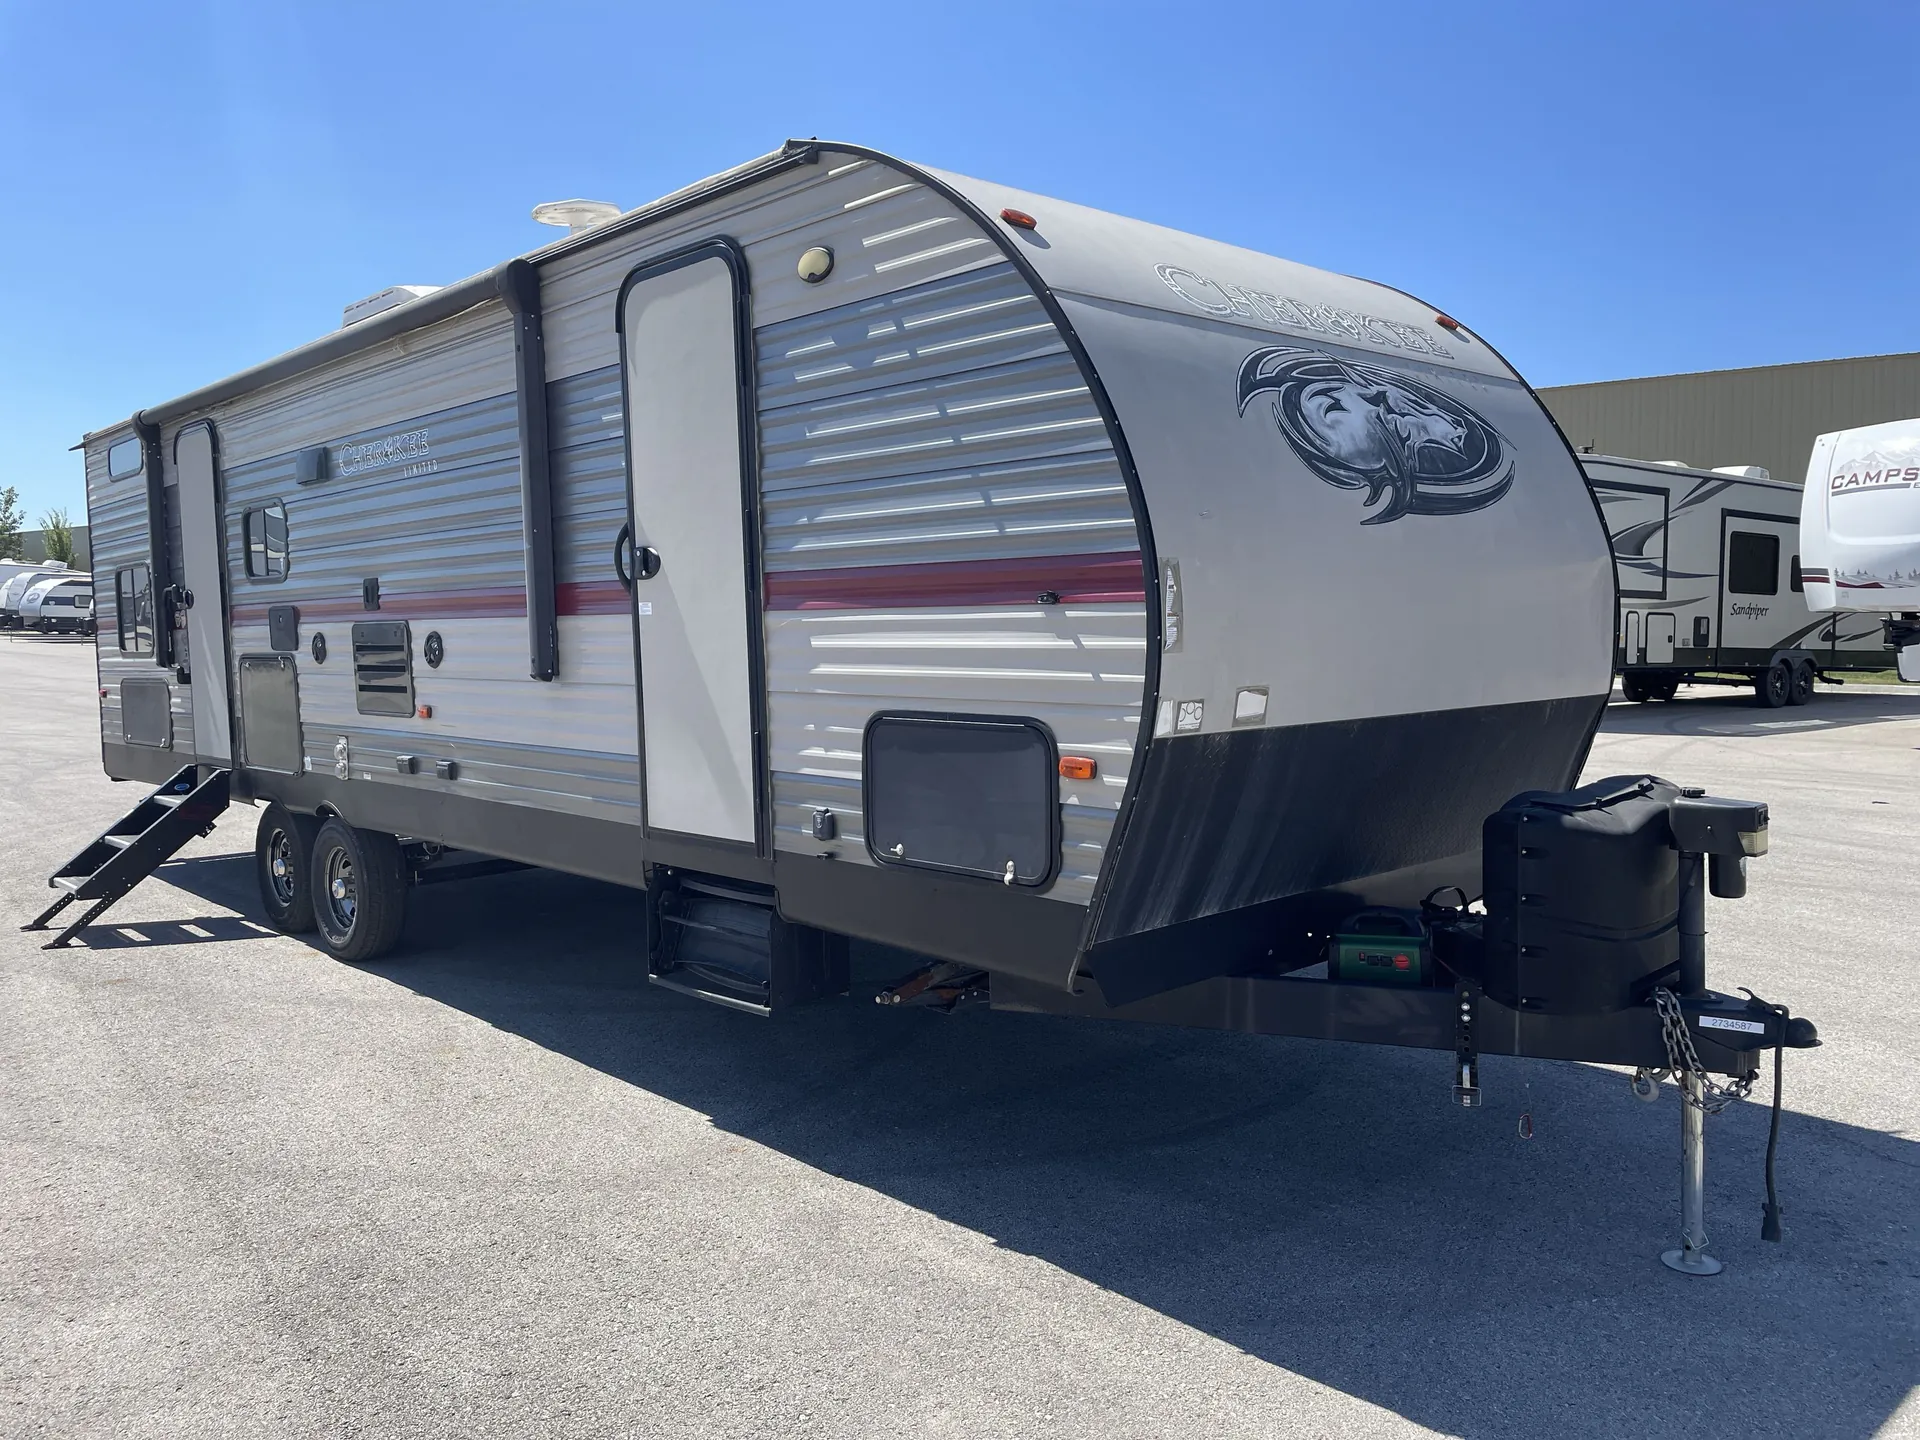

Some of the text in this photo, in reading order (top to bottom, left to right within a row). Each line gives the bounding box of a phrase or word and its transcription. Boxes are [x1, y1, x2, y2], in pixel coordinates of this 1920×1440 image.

[1153, 262, 1455, 360] CHEROKEE
[340, 428, 429, 477] CHEROKEE
[404, 459, 438, 477] LIMITED
[1730, 602, 1769, 620] Sandpiper
[1712, 1018, 1752, 1030] 2734587
